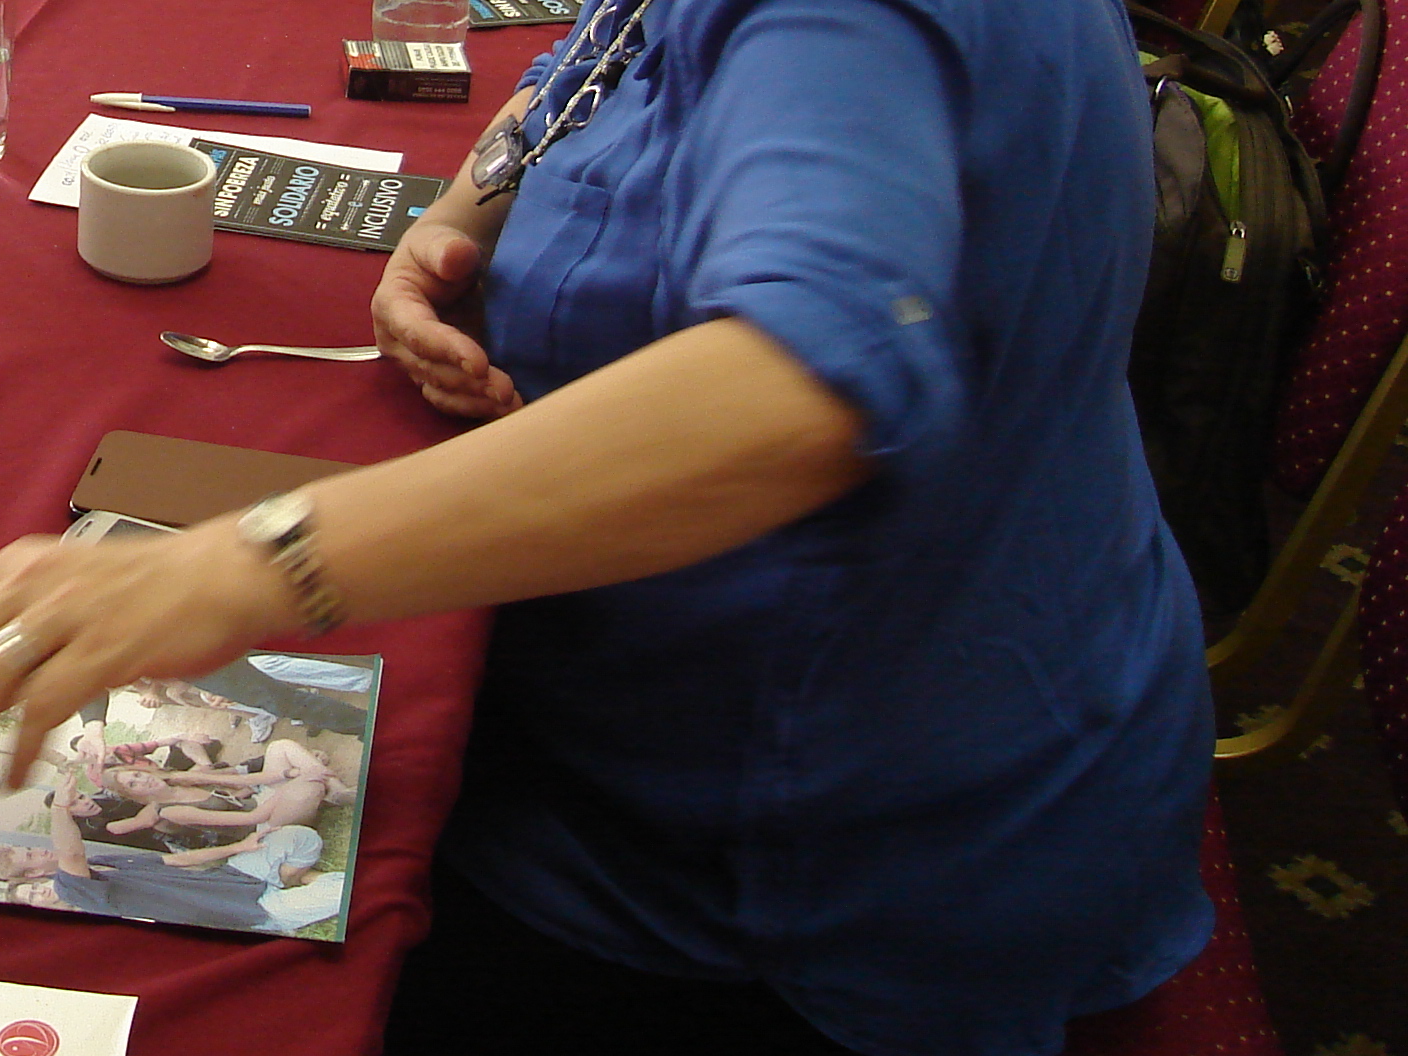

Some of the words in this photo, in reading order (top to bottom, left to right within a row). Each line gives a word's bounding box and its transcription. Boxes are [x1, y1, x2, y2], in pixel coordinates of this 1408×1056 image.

[268, 166, 319, 227] SOLIDARIO
[320, 181, 348, 222] equitativo
[357, 179, 403, 239] INCLUSIVO
